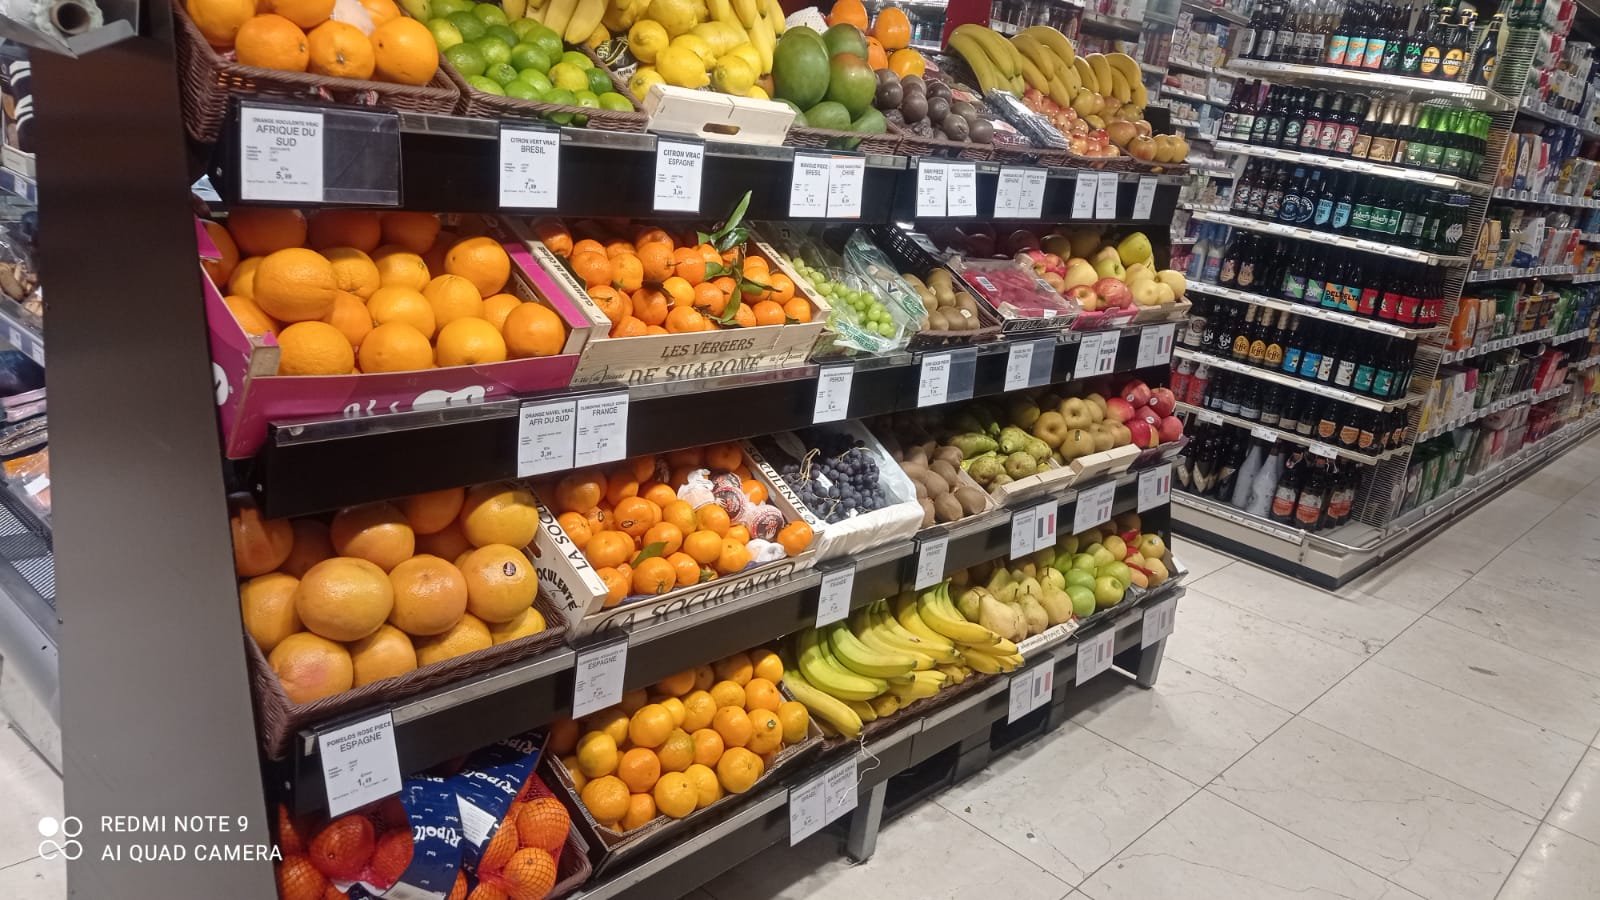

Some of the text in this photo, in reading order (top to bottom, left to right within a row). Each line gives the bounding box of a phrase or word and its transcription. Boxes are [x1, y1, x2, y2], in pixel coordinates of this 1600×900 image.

[256, 125, 316, 137] AFRIQUE DU
[276, 136, 297, 147] SUD
[520, 145, 546, 154] BRESIL
[663, 149, 701, 159] CITRON VRAC
[668, 158, 695, 167] ESPAGNE
[661, 338, 755, 358] LES VERGERS
[592, 406, 618, 416] FRANCE
[555, 414, 570, 422] SUD
[568, 549, 589, 570] LA
[587, 655, 617, 670] ESPAGNE
[326, 721, 391, 748] POMELOS ROSE PIECE
[340, 731, 382, 752] ESPAGNE
[413, 825, 463, 848] Ripoll
